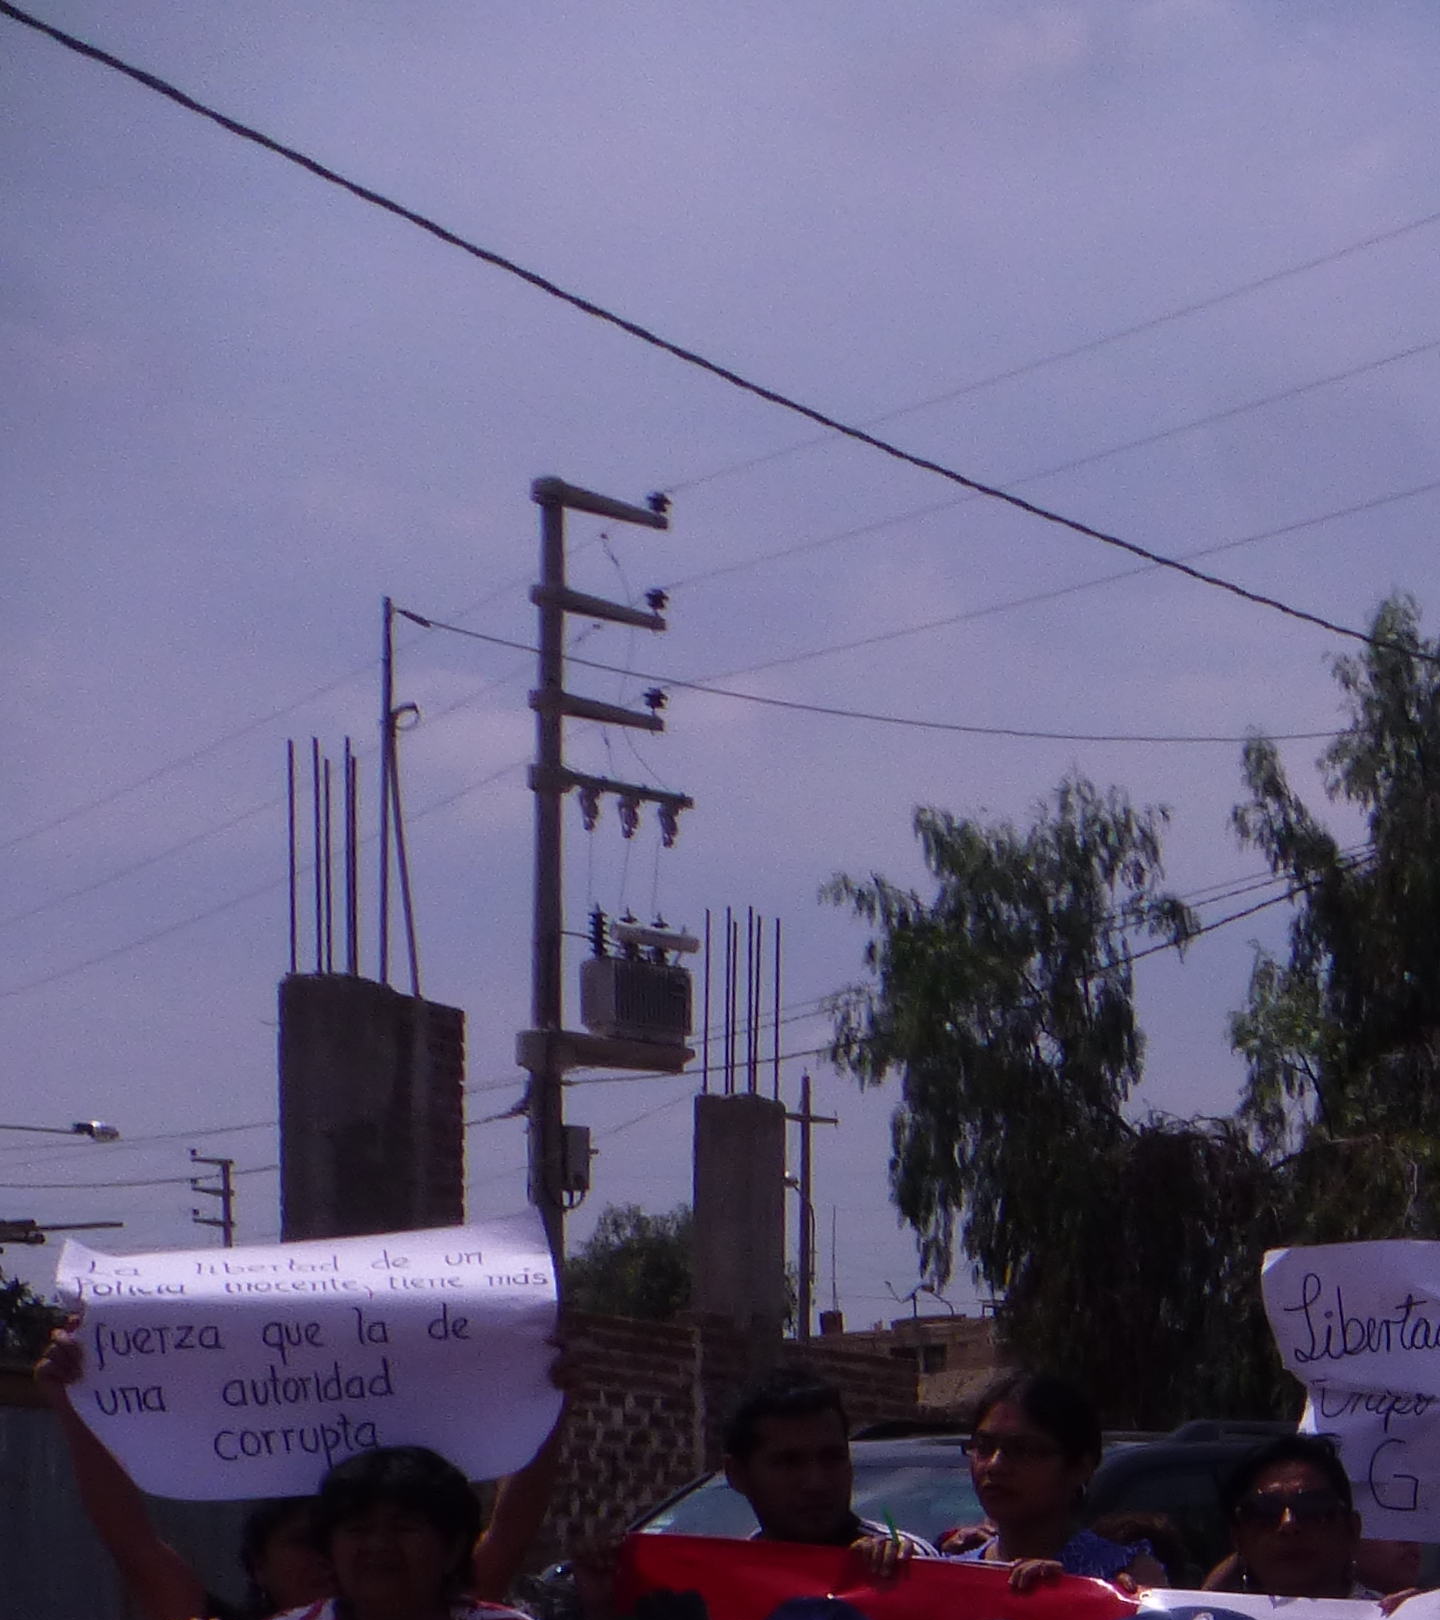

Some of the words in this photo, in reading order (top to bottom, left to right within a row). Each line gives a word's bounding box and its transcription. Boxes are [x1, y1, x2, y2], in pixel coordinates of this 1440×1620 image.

[88, 1262, 140, 1278] La
[196, 1253, 340, 1277] libertad
[371, 1249, 410, 1272] de
[445, 1250, 485, 1267] un
[389, 1270, 464, 1290] tiene
[487, 1264, 550, 1288] más
[94, 1320, 225, 1369] fuerza
[262, 1319, 324, 1363] que
[353, 1306, 390, 1345] la
[428, 1303, 470, 1342] de
[94, 1384, 166, 1417] una
[221, 1357, 395, 1407] autoridad
[212, 1414, 379, 1467] corrupta
